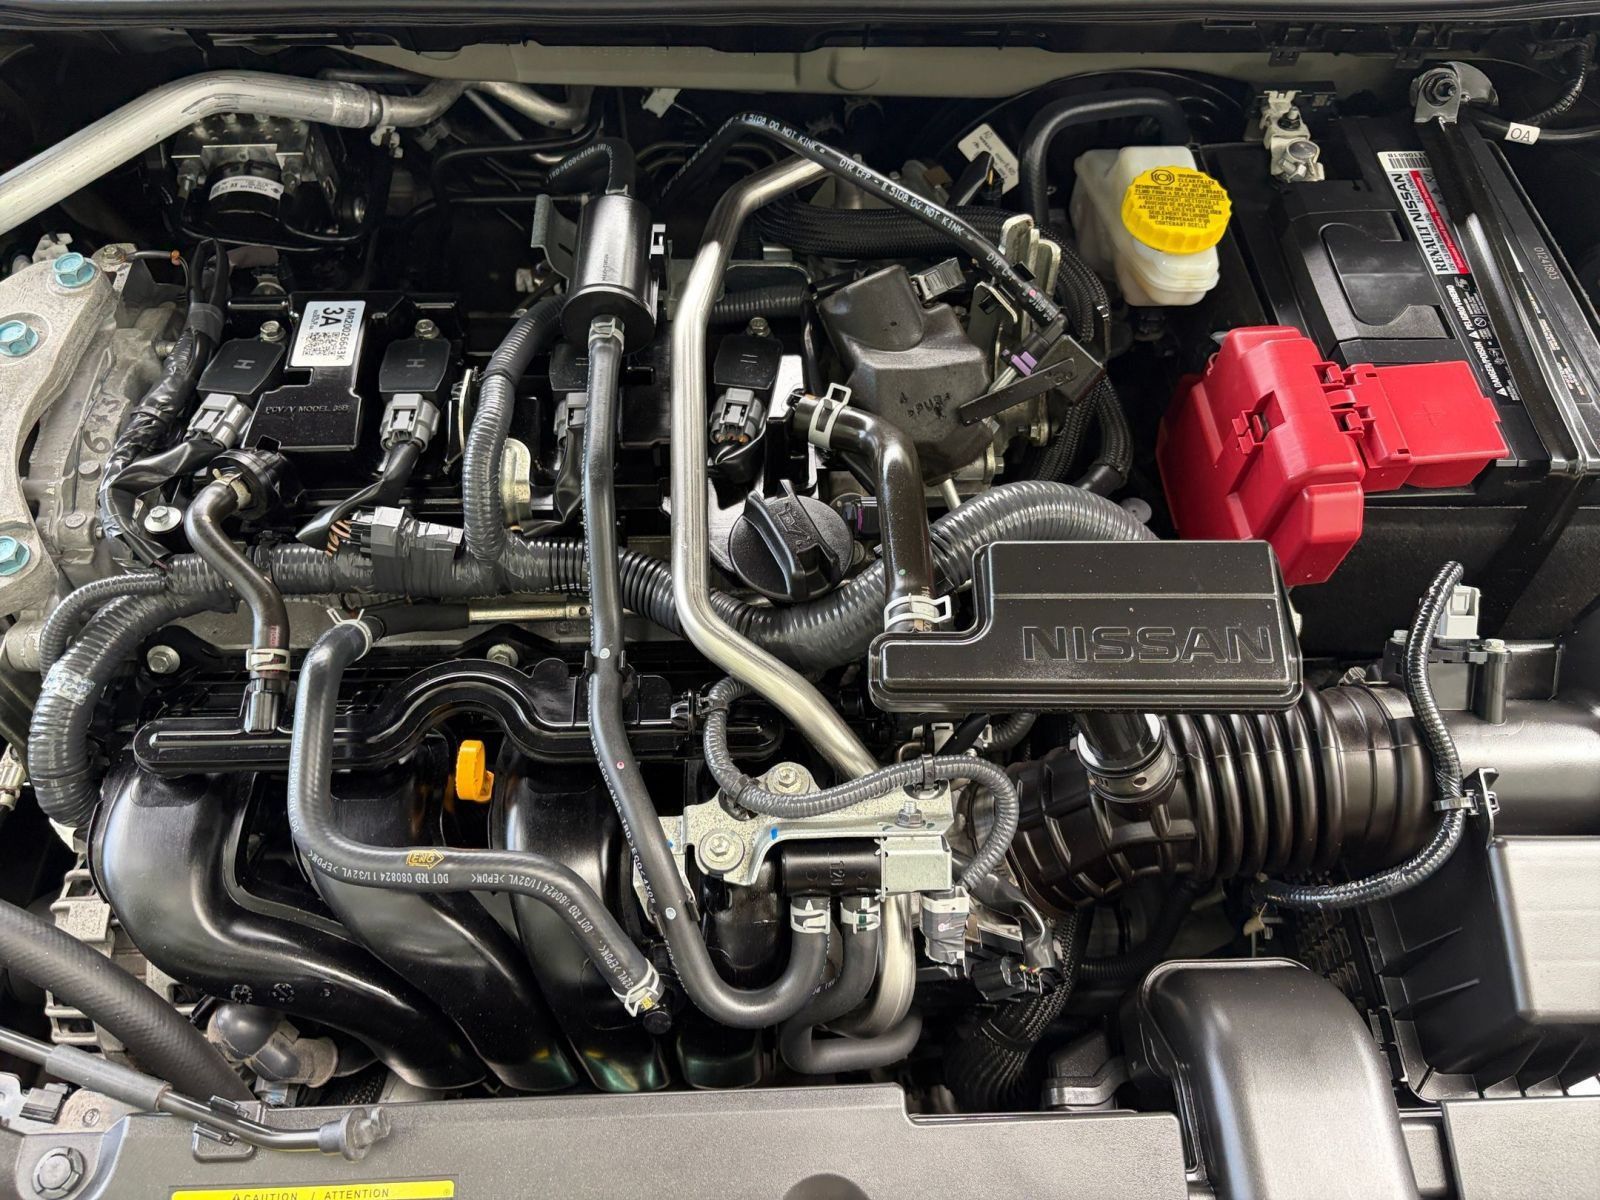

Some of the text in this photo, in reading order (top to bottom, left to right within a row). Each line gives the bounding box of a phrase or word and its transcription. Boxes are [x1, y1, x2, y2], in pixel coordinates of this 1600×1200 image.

[781, 126, 798, 140] NOT
[798, 134, 818, 151] KINK
[923, 205, 941, 220] NOT
[940, 216, 965, 236] KINK
[1391, 173, 1448, 272] RENAULT NISSAN
[319, 307, 344, 327] 3A
[1022, 626, 1274, 664] NISSAN
[411, 852, 435, 864] ENG
[380, 872, 413, 883] 080824
[432, 873, 449, 884] DOT
[577, 918, 594, 933] DOT
[324, 1188, 390, 1200] ATTENTION
